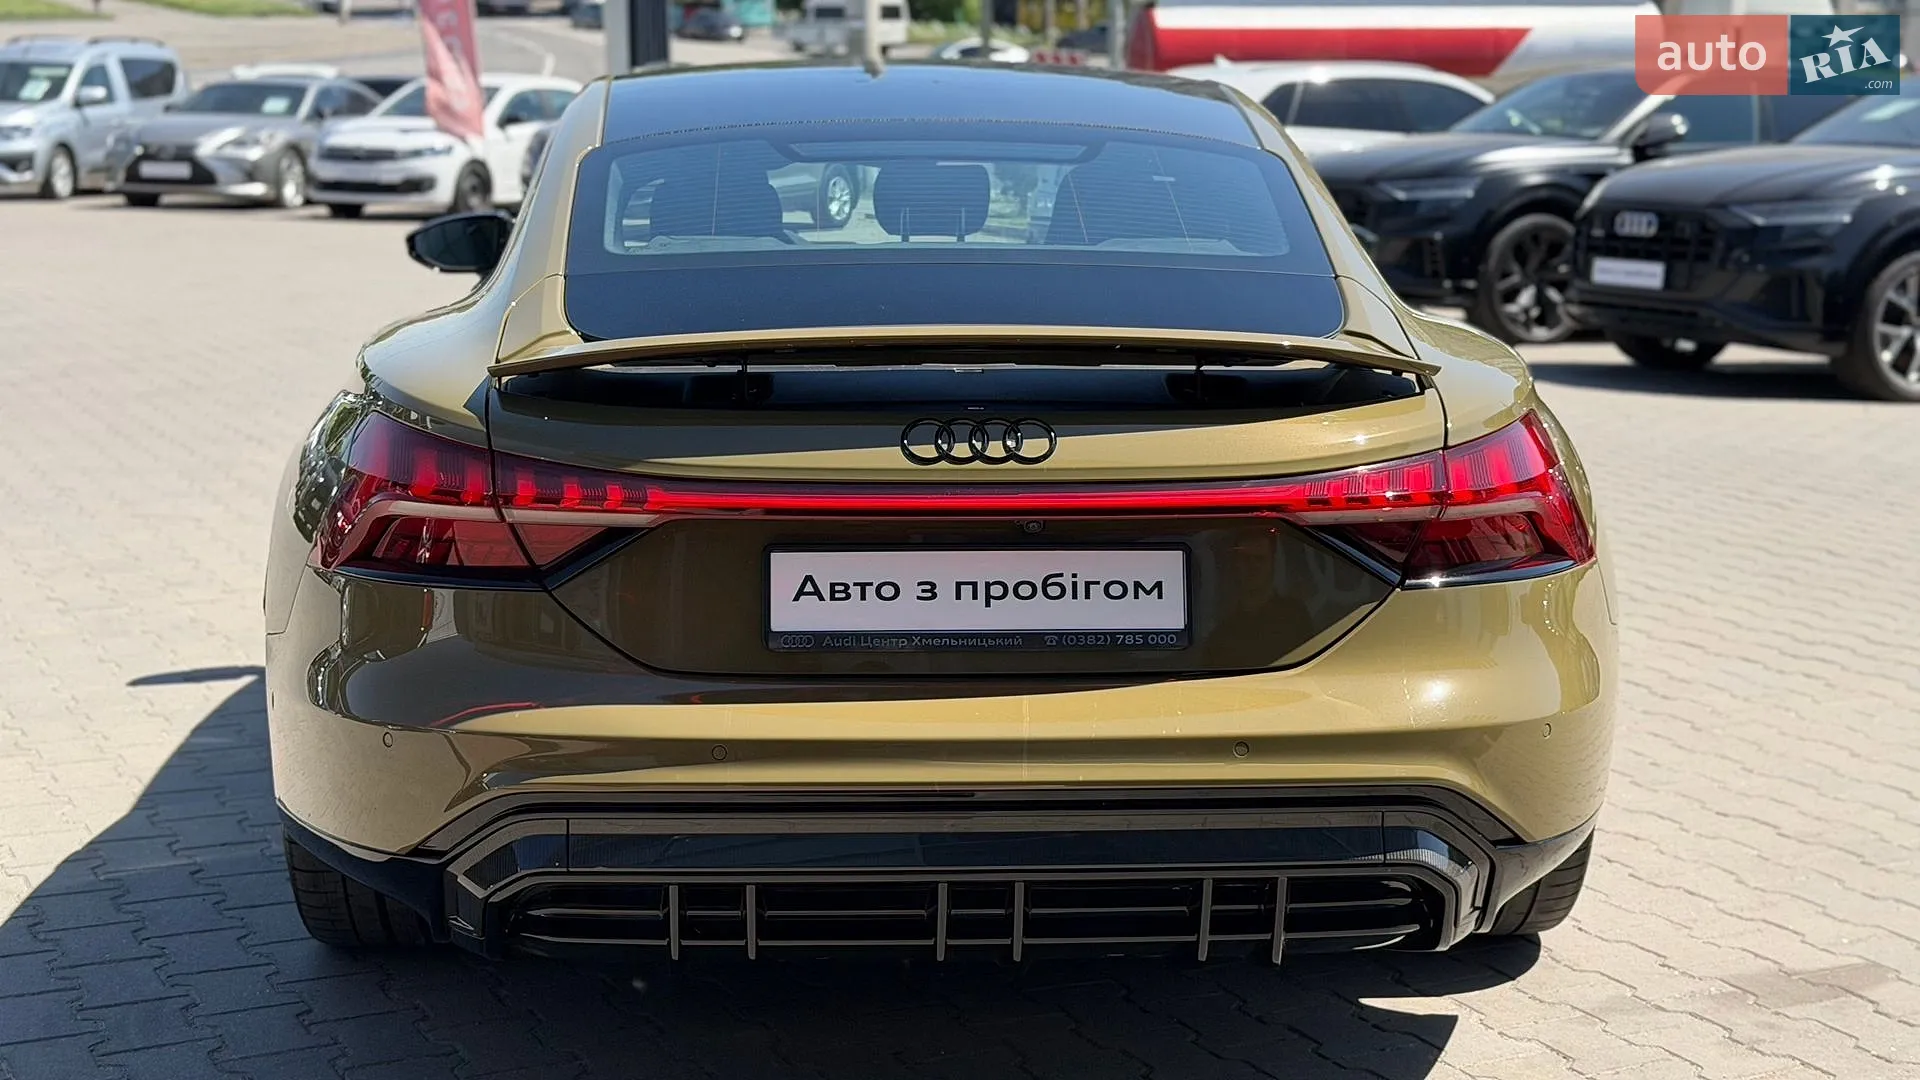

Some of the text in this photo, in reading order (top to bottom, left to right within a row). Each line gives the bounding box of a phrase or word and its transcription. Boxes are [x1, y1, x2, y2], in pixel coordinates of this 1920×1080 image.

[791, 572, 1165, 608] Авто з пробігом
[821, 633, 1177, 649] Audi Центр Хмельницький (0382) 785 000
